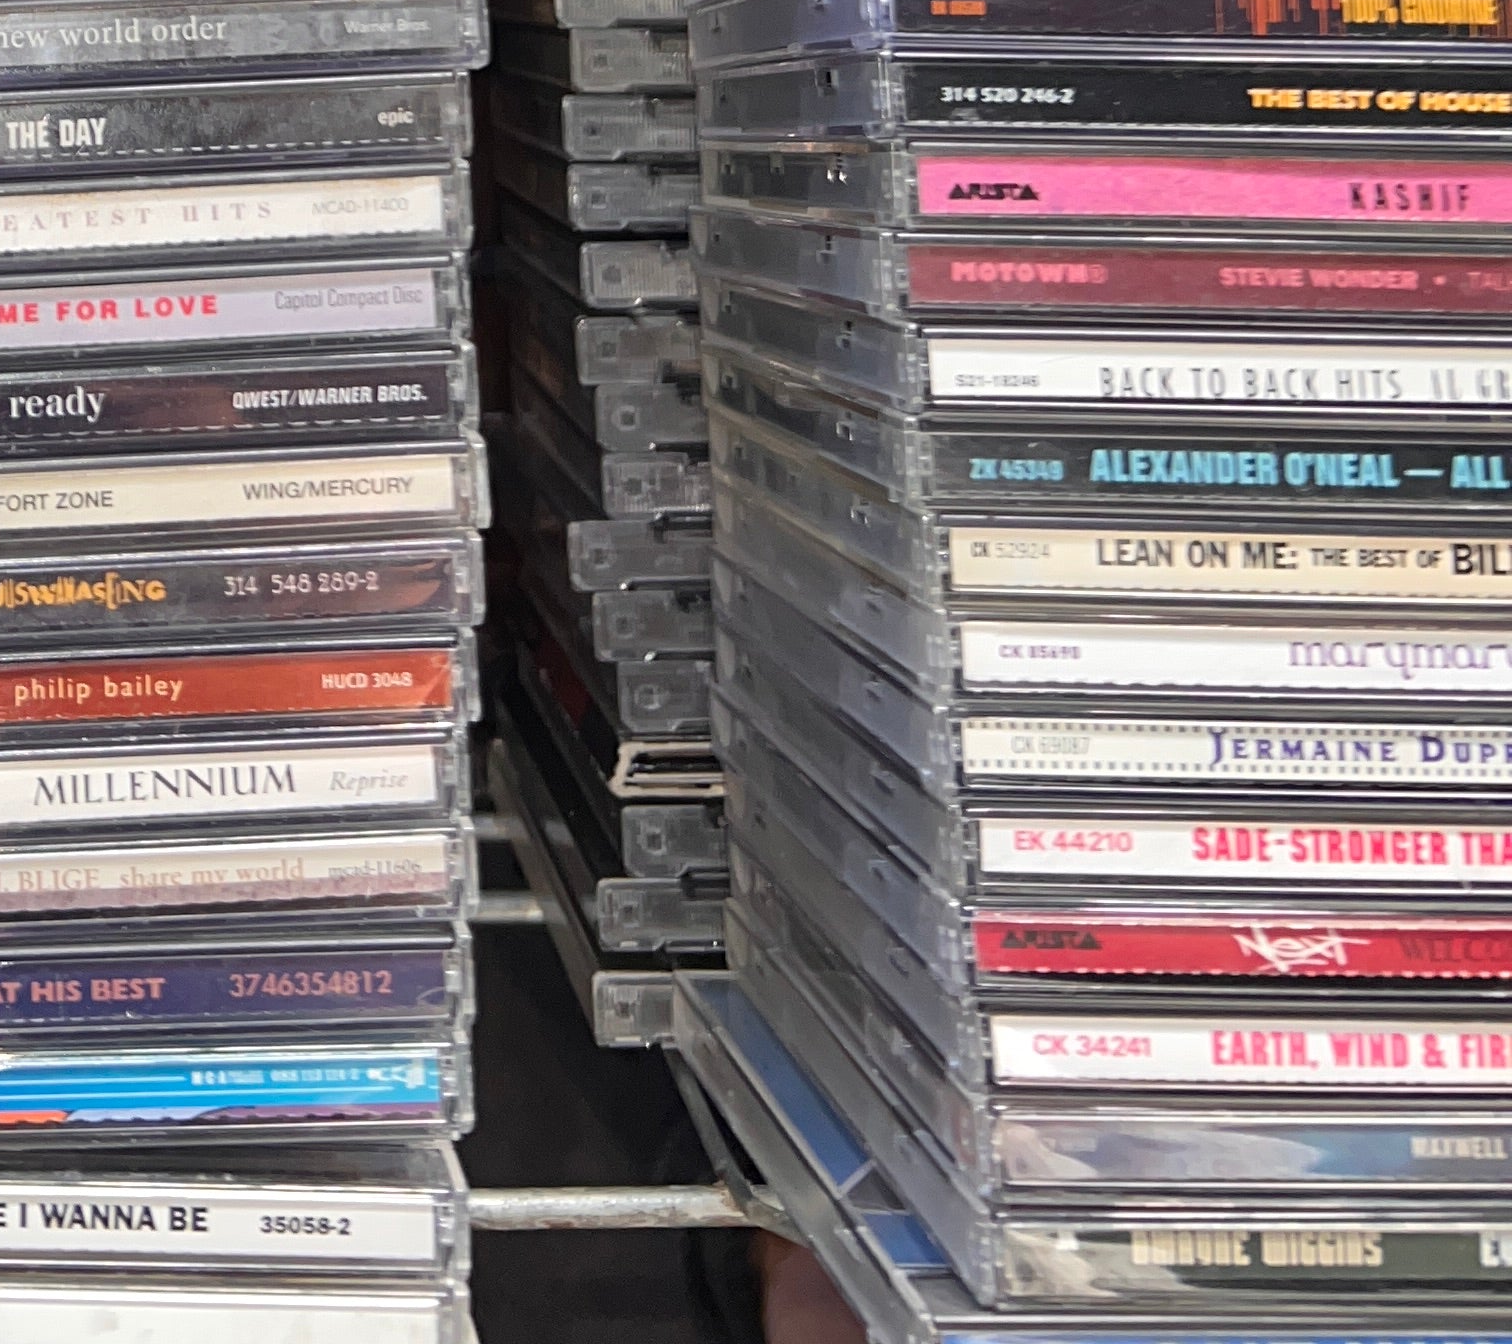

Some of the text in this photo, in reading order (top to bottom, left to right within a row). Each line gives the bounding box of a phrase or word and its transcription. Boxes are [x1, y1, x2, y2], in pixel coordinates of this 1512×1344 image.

[1247, 88, 1512, 112] THE BEST OF HOUSE
[376, 106, 414, 127] epic
[5, 119, 50, 150] THE
[58, 116, 107, 147] DAY
[948, 183, 1040, 201] ARISTA
[1347, 182, 1472, 211] KASHIF
[181, 201, 274, 223] HITS
[1098, 367, 1403, 400] BACK TO BACK HITS
[55, 490, 114, 509] ZONE
[242, 477, 413, 502] WING/MERCURY
[970, 542, 1051, 559] CK 52924
[1095, 537, 1443, 570] LEAN ON ME: THE BEST OF
[322, 671, 413, 689] HUCD 3048
[33, 765, 298, 807] MILLENNIUM
[330, 768, 408, 795] Reprise
[1013, 830, 1133, 853] EK 44210
[30, 979, 82, 1003] HIS
[90, 976, 167, 1002] BEST
[228, 969, 393, 999] 3746354812
[1032, 1033, 1152, 1058] CK 34241
[1409, 1135, 1509, 1160] MAXWELL
[19, 1202, 28, 1228] I
[39, 1202, 158, 1232] WANNA
[168, 1206, 210, 1232] BE
[260, 1214, 352, 1236] 35058-2
